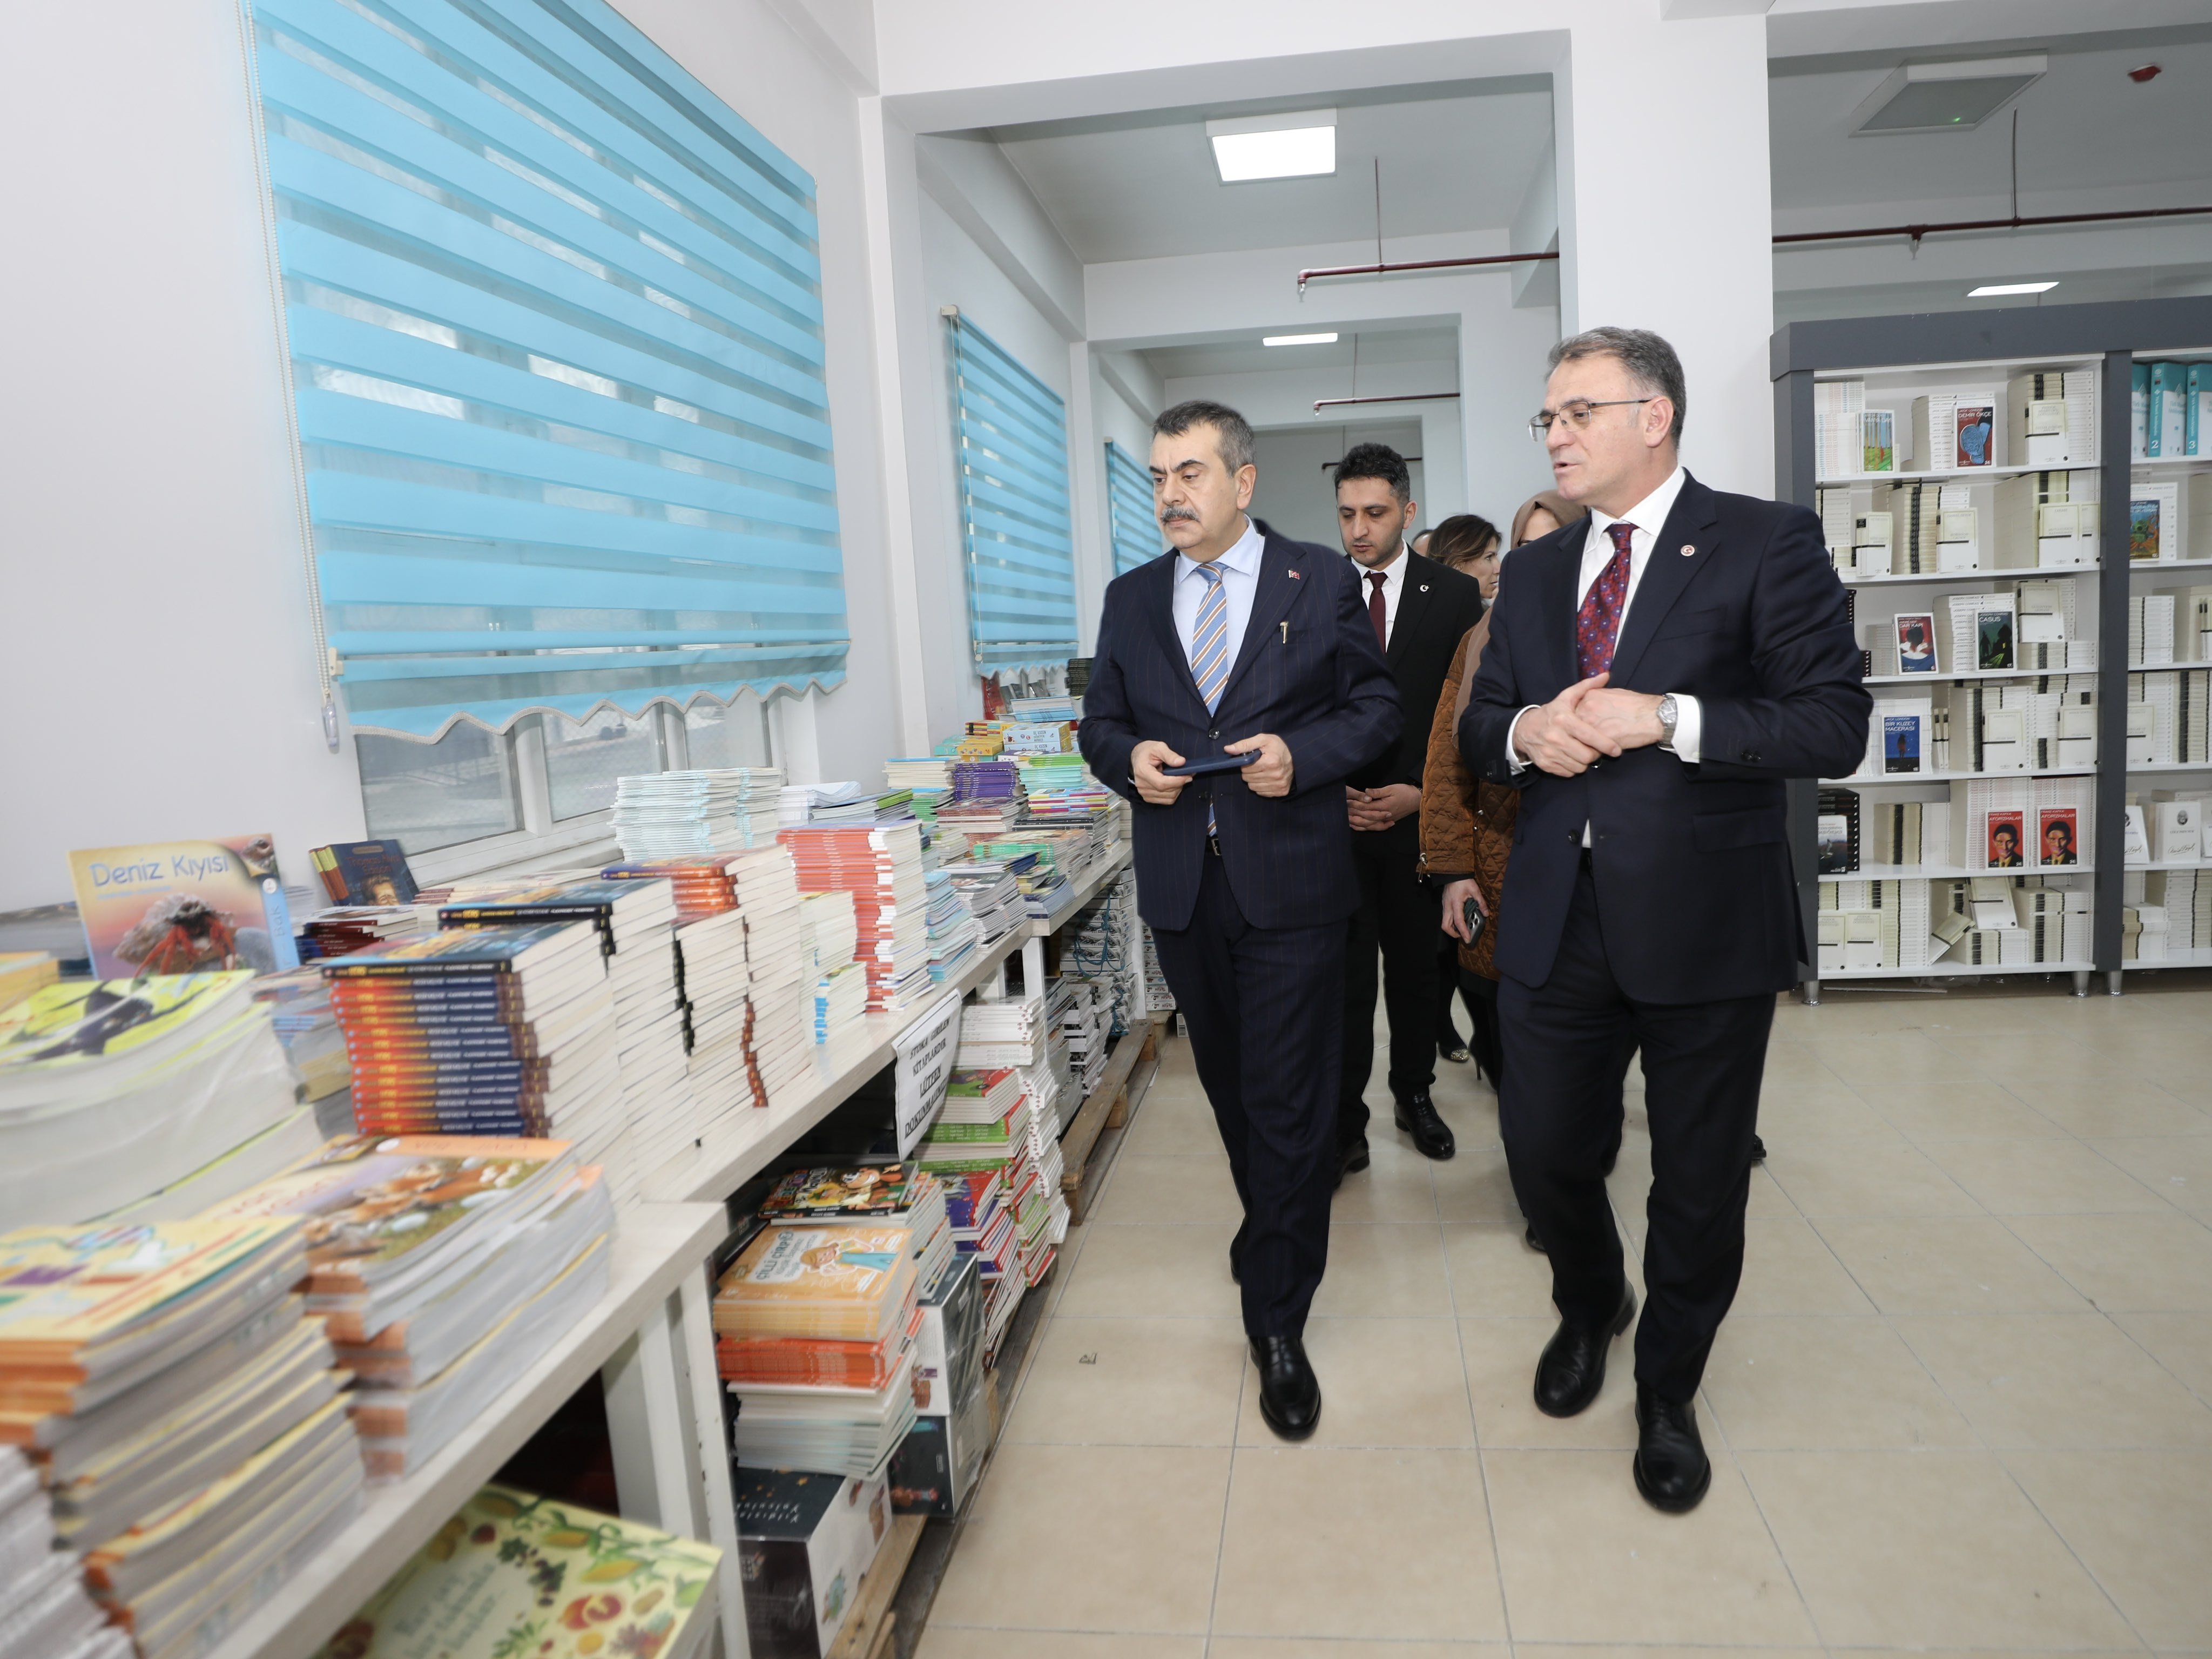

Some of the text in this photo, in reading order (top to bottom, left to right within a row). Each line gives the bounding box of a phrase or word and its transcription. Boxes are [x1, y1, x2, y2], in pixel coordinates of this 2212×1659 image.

[2152, 441, 2159, 449] 2
[2189, 441, 2196, 449] 3
[89, 858, 164, 888] Deniz
[912, 1037, 947, 1077] KİTAPLARDIR
[919, 1063, 942, 1099] LÜTFEN
